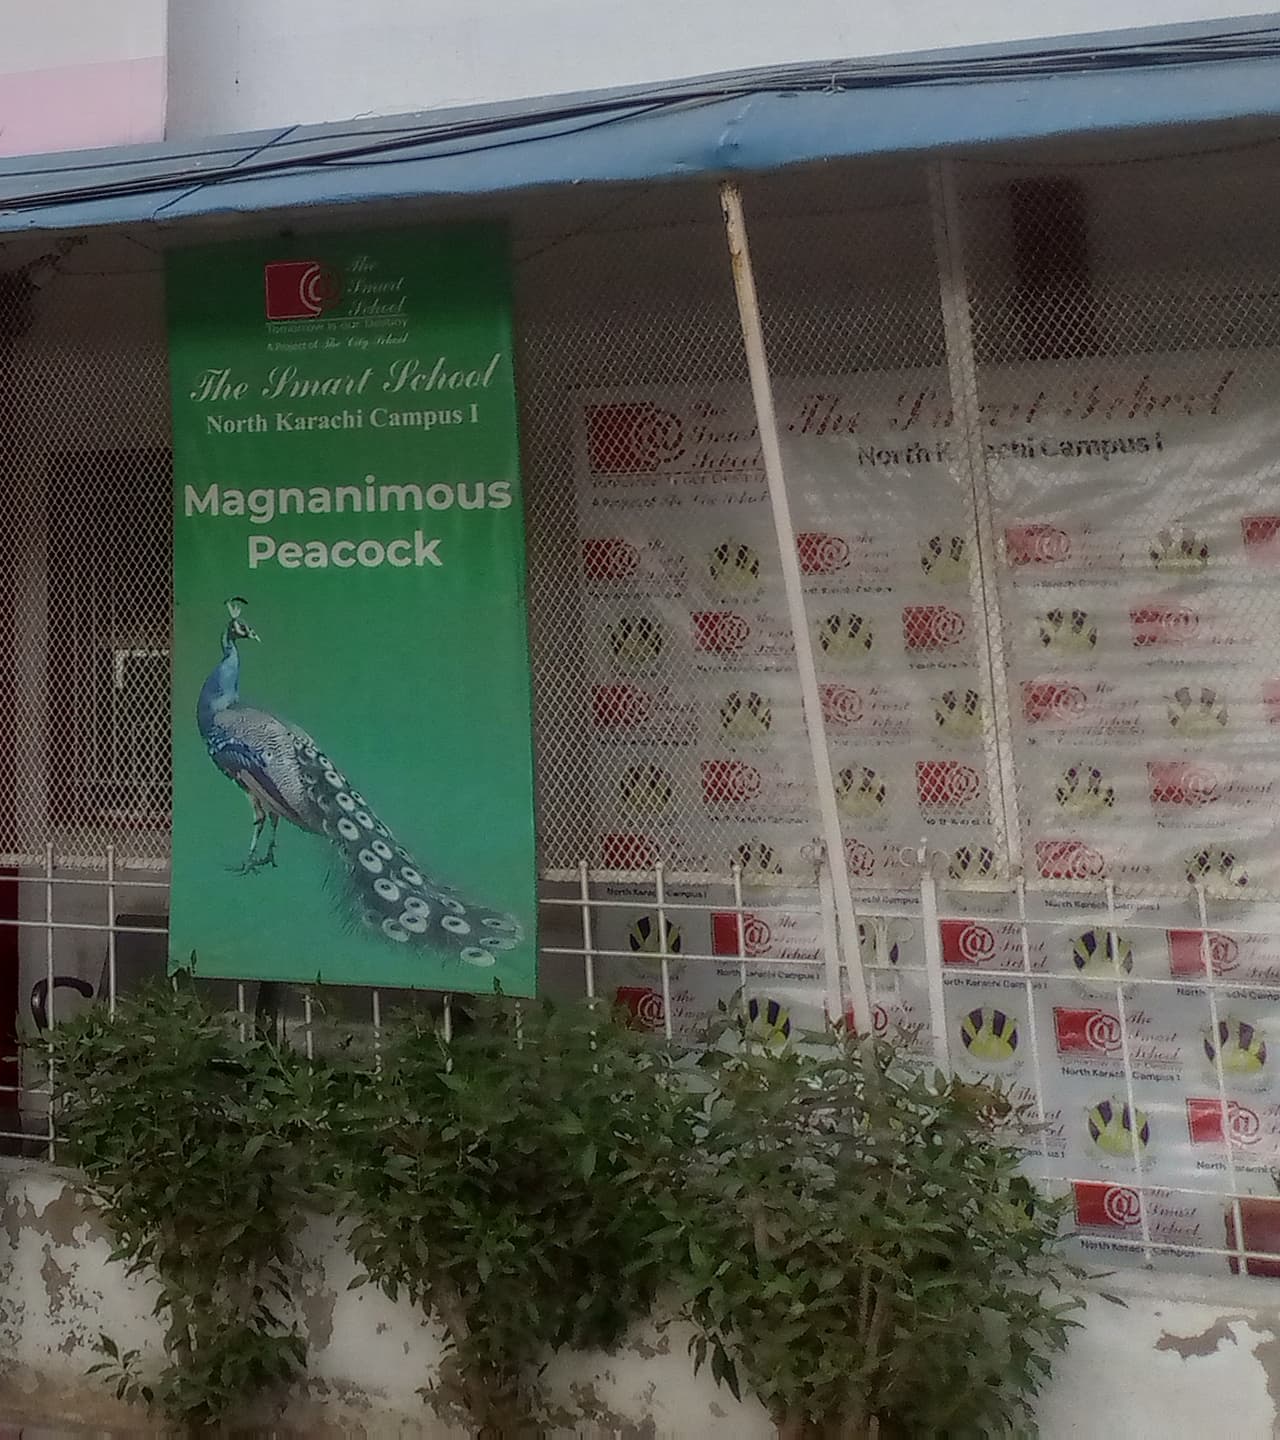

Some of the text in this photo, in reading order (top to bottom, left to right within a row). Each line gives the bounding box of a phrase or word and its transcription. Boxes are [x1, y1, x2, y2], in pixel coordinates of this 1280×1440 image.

[190, 352, 502, 403] The Smart School
[206, 411, 268, 435] North
[275, 408, 364, 432] Karachi
[369, 406, 463, 432] Campus
[184, 474, 513, 524] Magnanimous
[247, 530, 443, 570] Peacock
